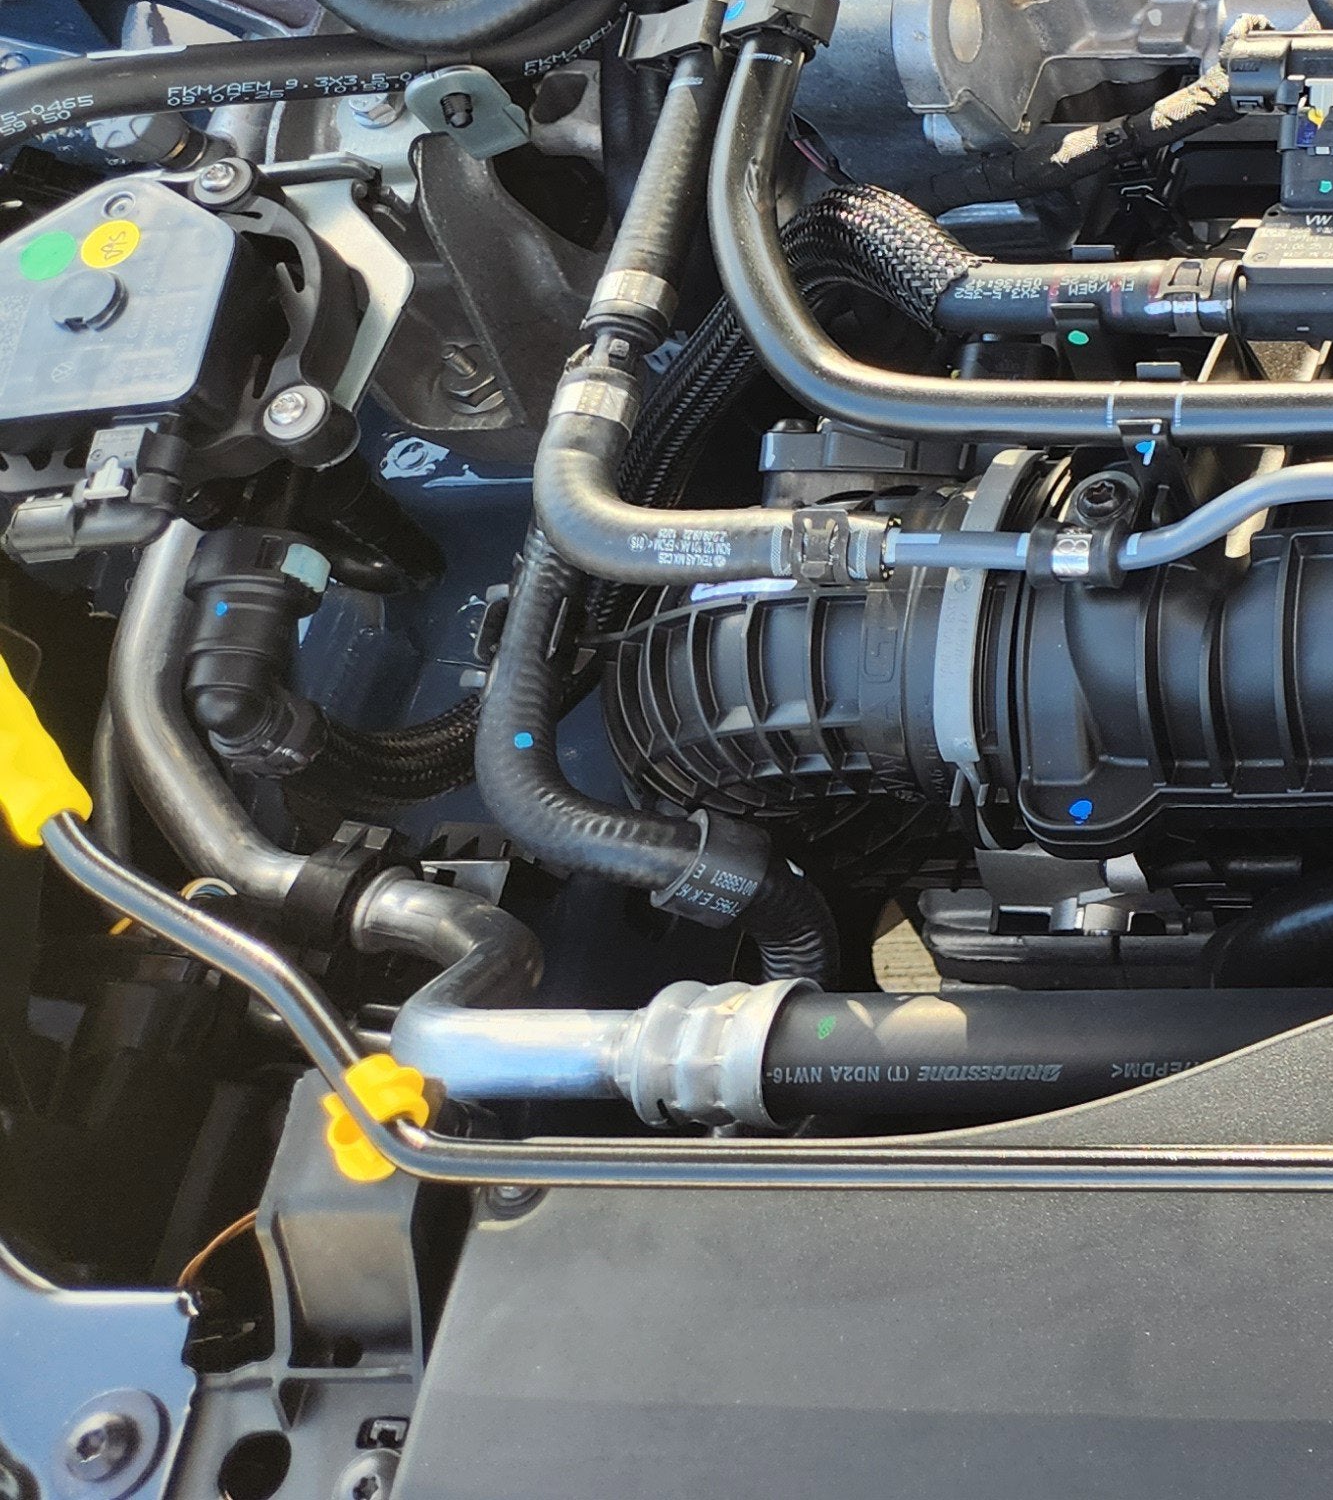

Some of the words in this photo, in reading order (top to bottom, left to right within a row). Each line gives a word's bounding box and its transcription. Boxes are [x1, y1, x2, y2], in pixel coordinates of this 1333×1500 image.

[167, 80, 271, 99] FKM/AEM
[1305, 214, 1333, 226] VW
[830, 1066, 880, 1084] ND2A
[917, 1063, 1063, 1083] BRIDGESTONE
